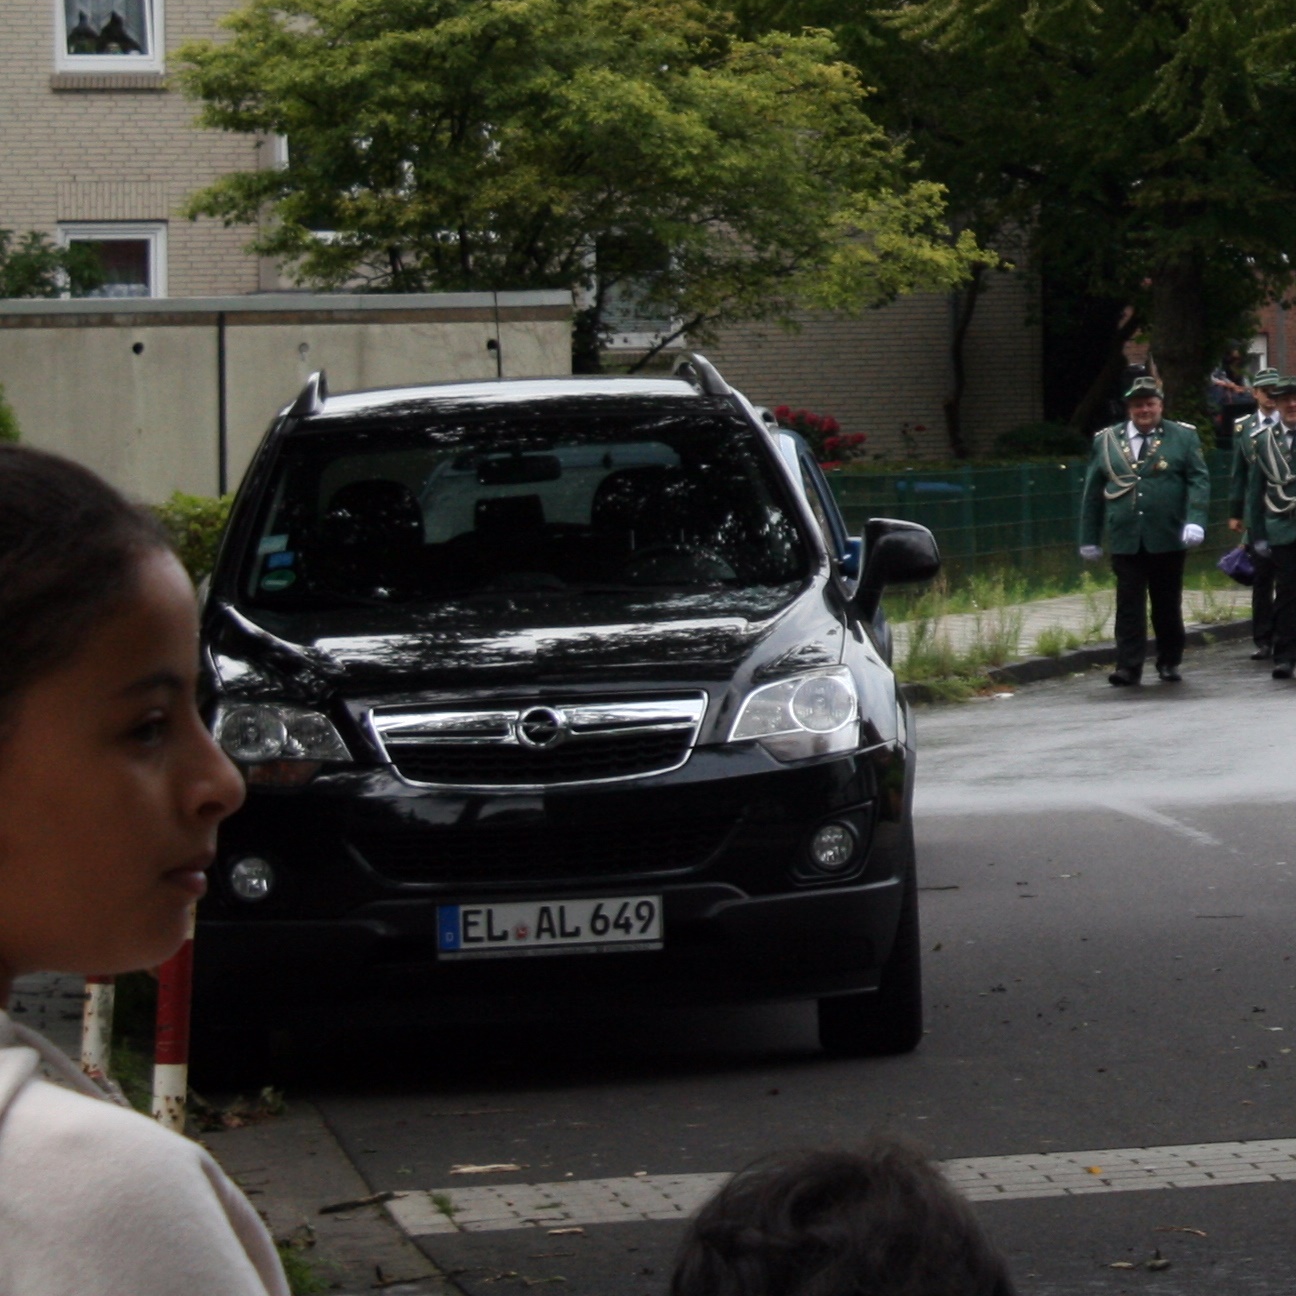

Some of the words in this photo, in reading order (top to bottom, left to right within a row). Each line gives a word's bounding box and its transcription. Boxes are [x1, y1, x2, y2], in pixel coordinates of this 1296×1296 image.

[462, 908, 508, 944] EL
[535, 905, 581, 940] AL
[590, 900, 655, 937] 649
